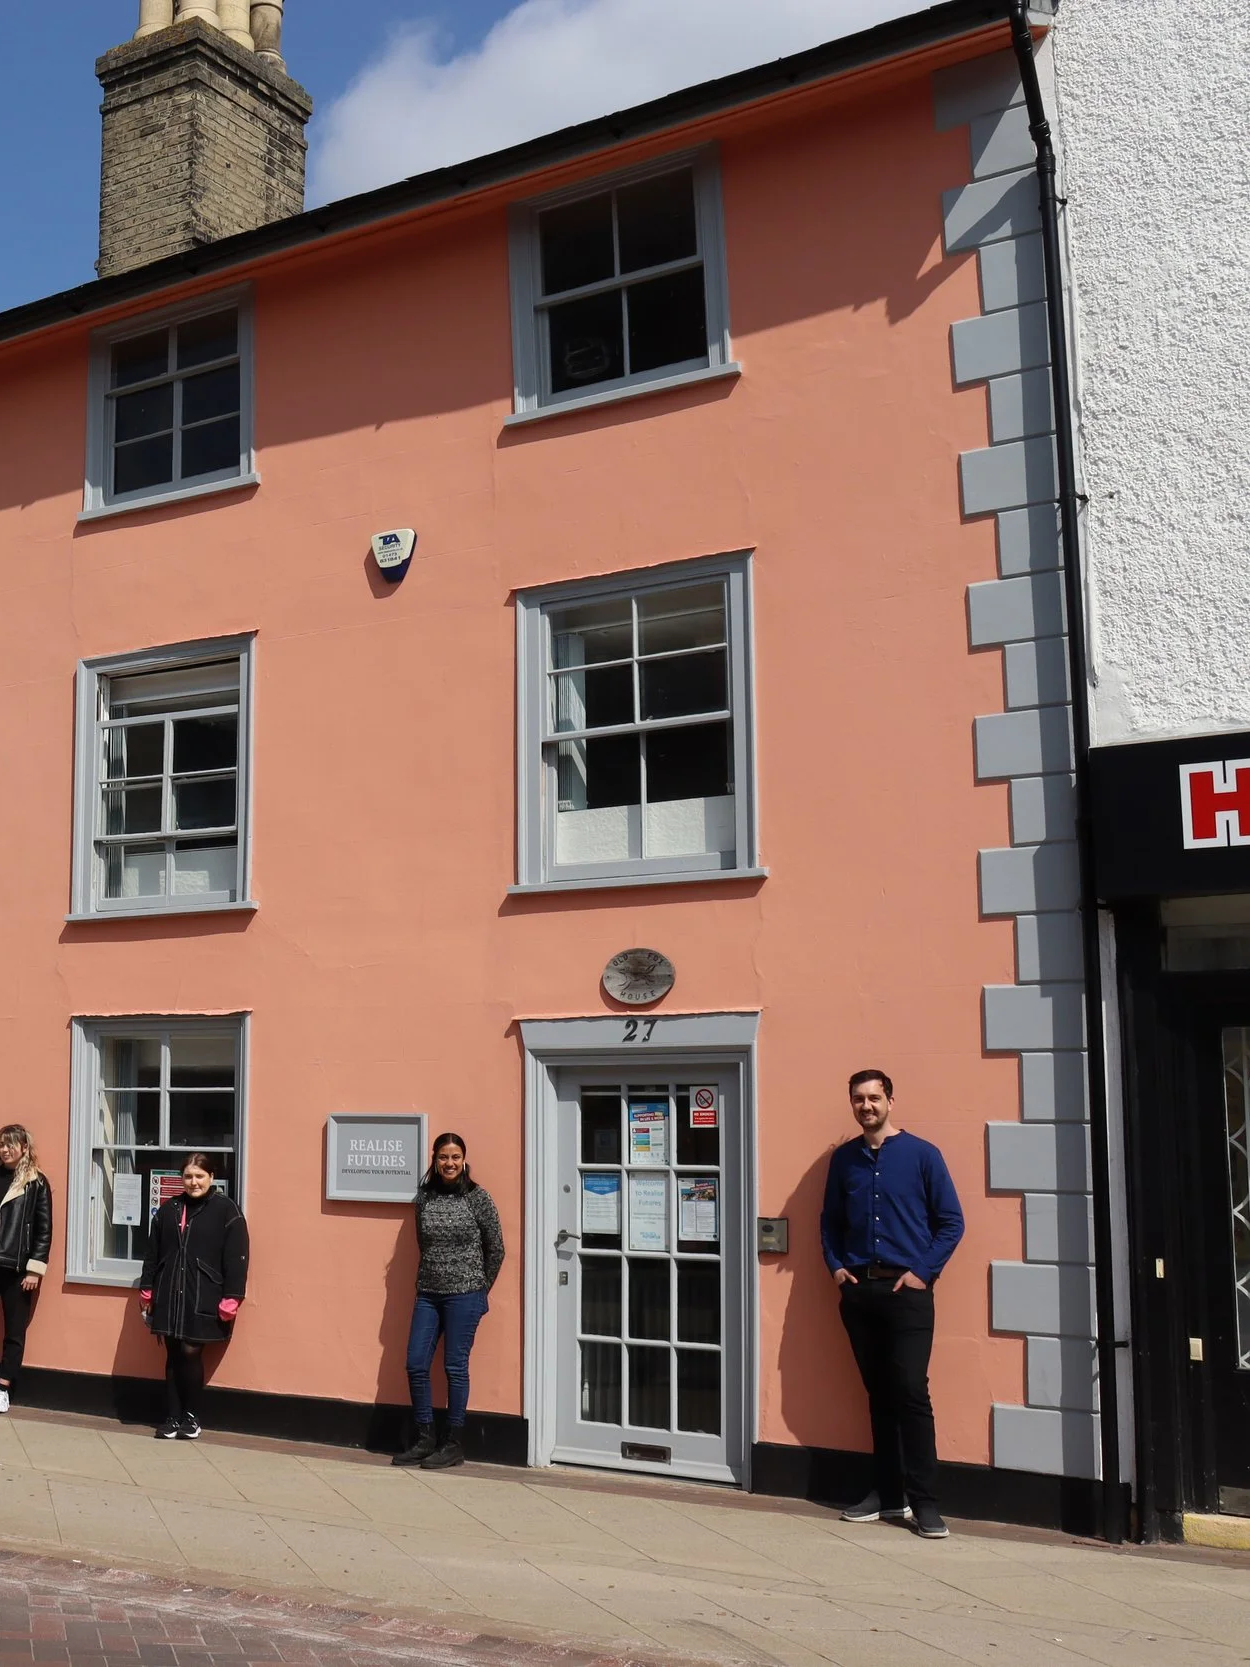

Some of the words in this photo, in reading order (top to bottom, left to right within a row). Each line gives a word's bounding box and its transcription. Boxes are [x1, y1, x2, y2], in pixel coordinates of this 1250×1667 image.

[613, 953, 628, 967] OLD
[647, 953, 664, 965] FOX
[620, 990, 656, 1000] HOUSE
[622, 1019, 658, 1043] 27
[350, 1139, 403, 1152] REALISE
[347, 1154, 406, 1168] FUTURES
